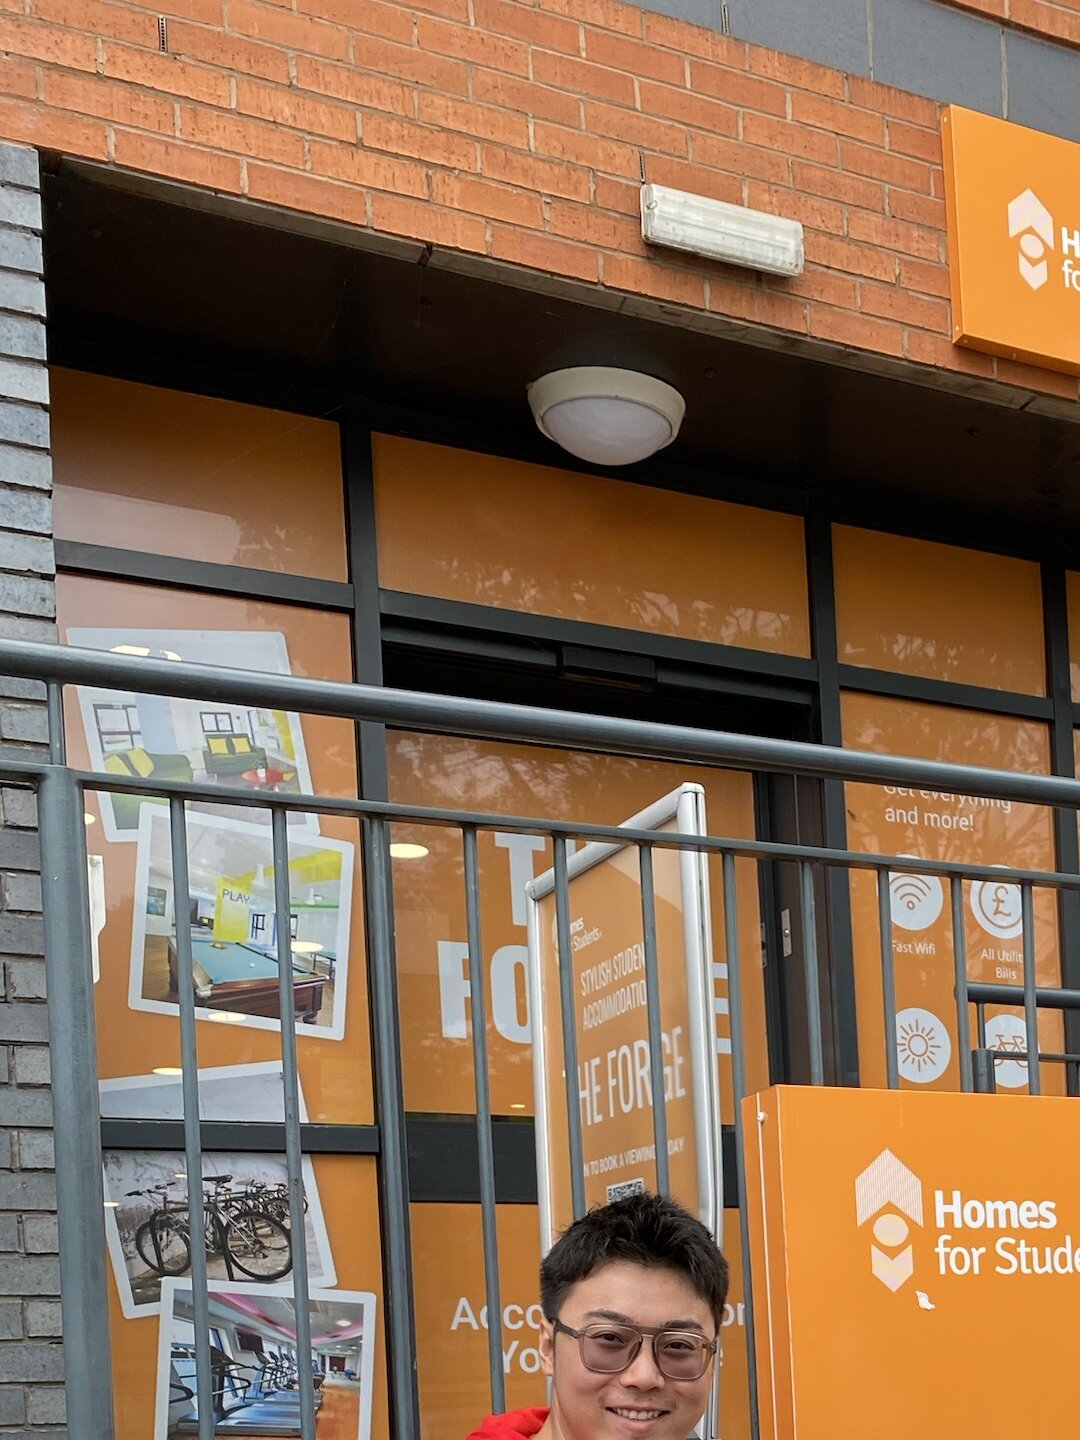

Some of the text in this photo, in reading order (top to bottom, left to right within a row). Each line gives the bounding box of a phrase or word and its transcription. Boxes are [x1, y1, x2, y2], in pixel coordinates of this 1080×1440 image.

[885, 806, 974, 832] and more!
[222, 888, 250, 905] PLAY
[891, 940, 936, 955] Fast Wifi
[981, 948, 1024, 963] All Utilit
[580, 941, 646, 997] STYLISH STUDEN
[995, 967, 1017, 980] Bills
[582, 979, 647, 1031] ACCOMMODATIO
[667, 1136, 685, 1156] DAY
[934, 1190, 1057, 1229] Homes
[934, 1235, 986, 1275] for
